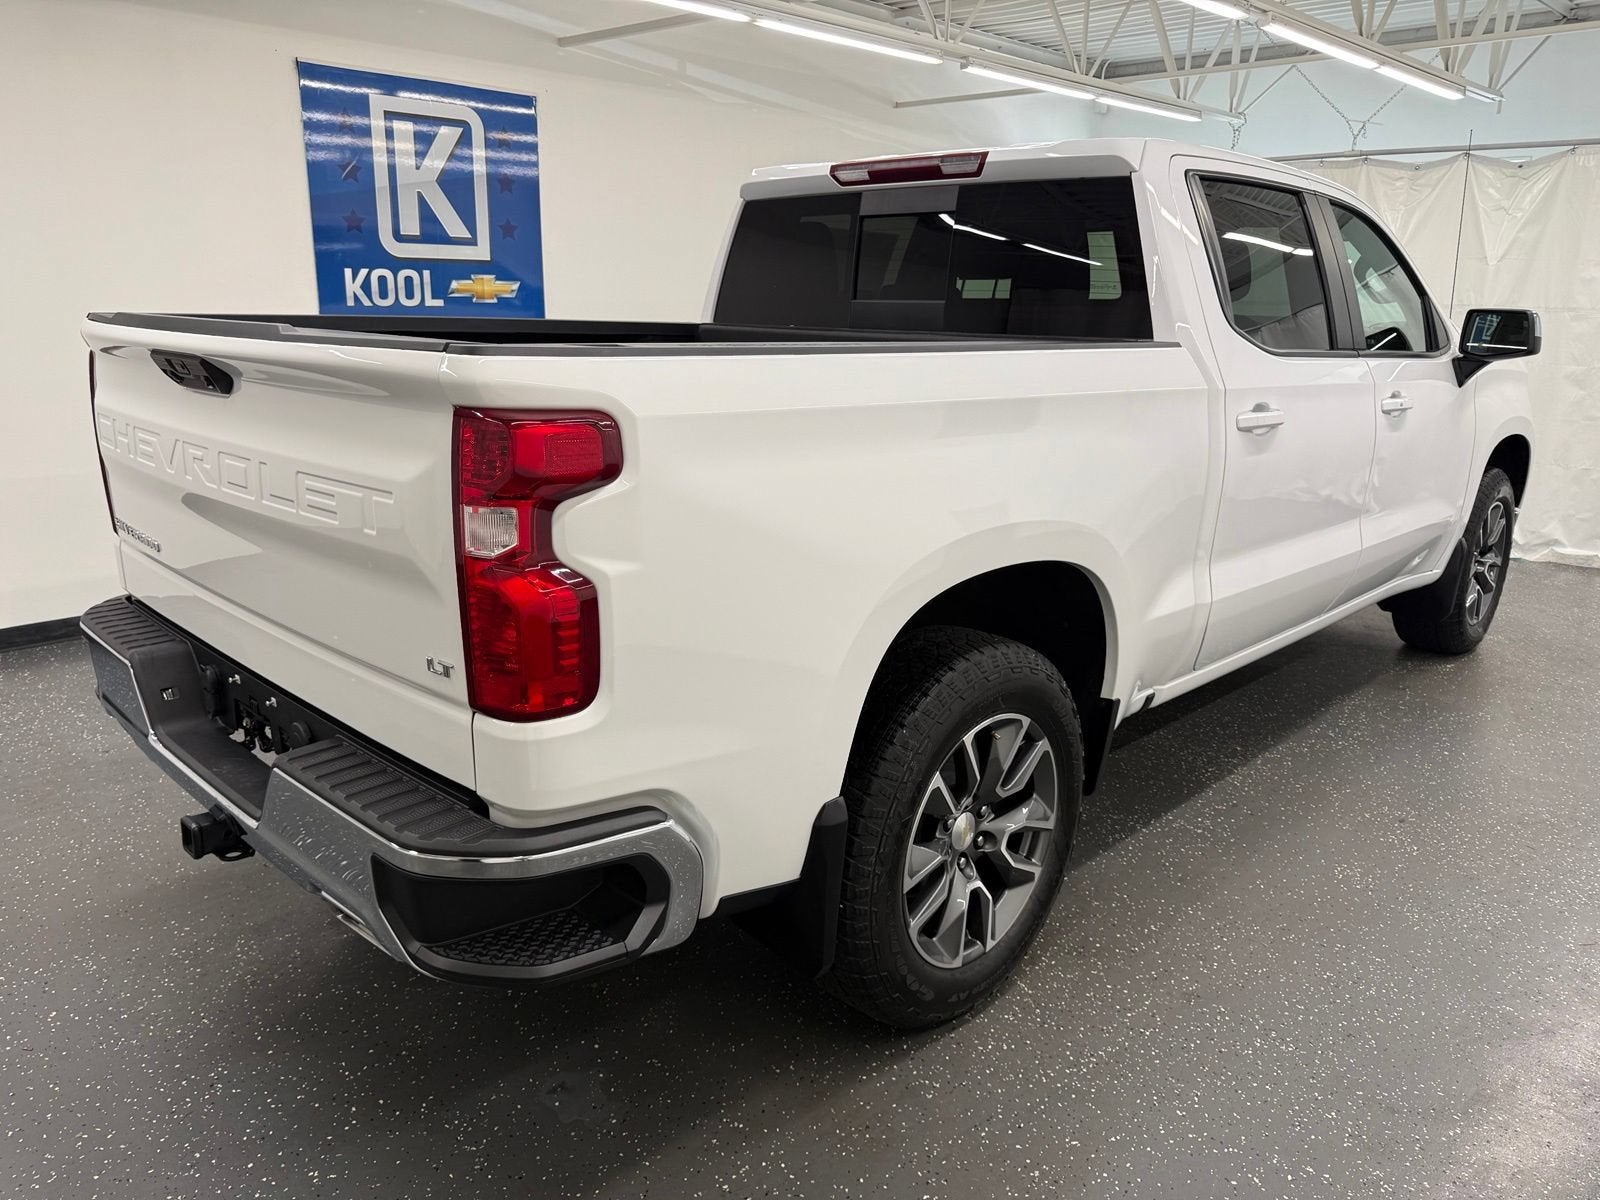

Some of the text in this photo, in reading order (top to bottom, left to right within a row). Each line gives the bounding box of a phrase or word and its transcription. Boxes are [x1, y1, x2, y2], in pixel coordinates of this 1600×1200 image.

[393, 119, 473, 238] K
[344, 267, 444, 307] KOOL
[97, 411, 394, 536] CHEVROLET
[425, 656, 455, 678] LT
